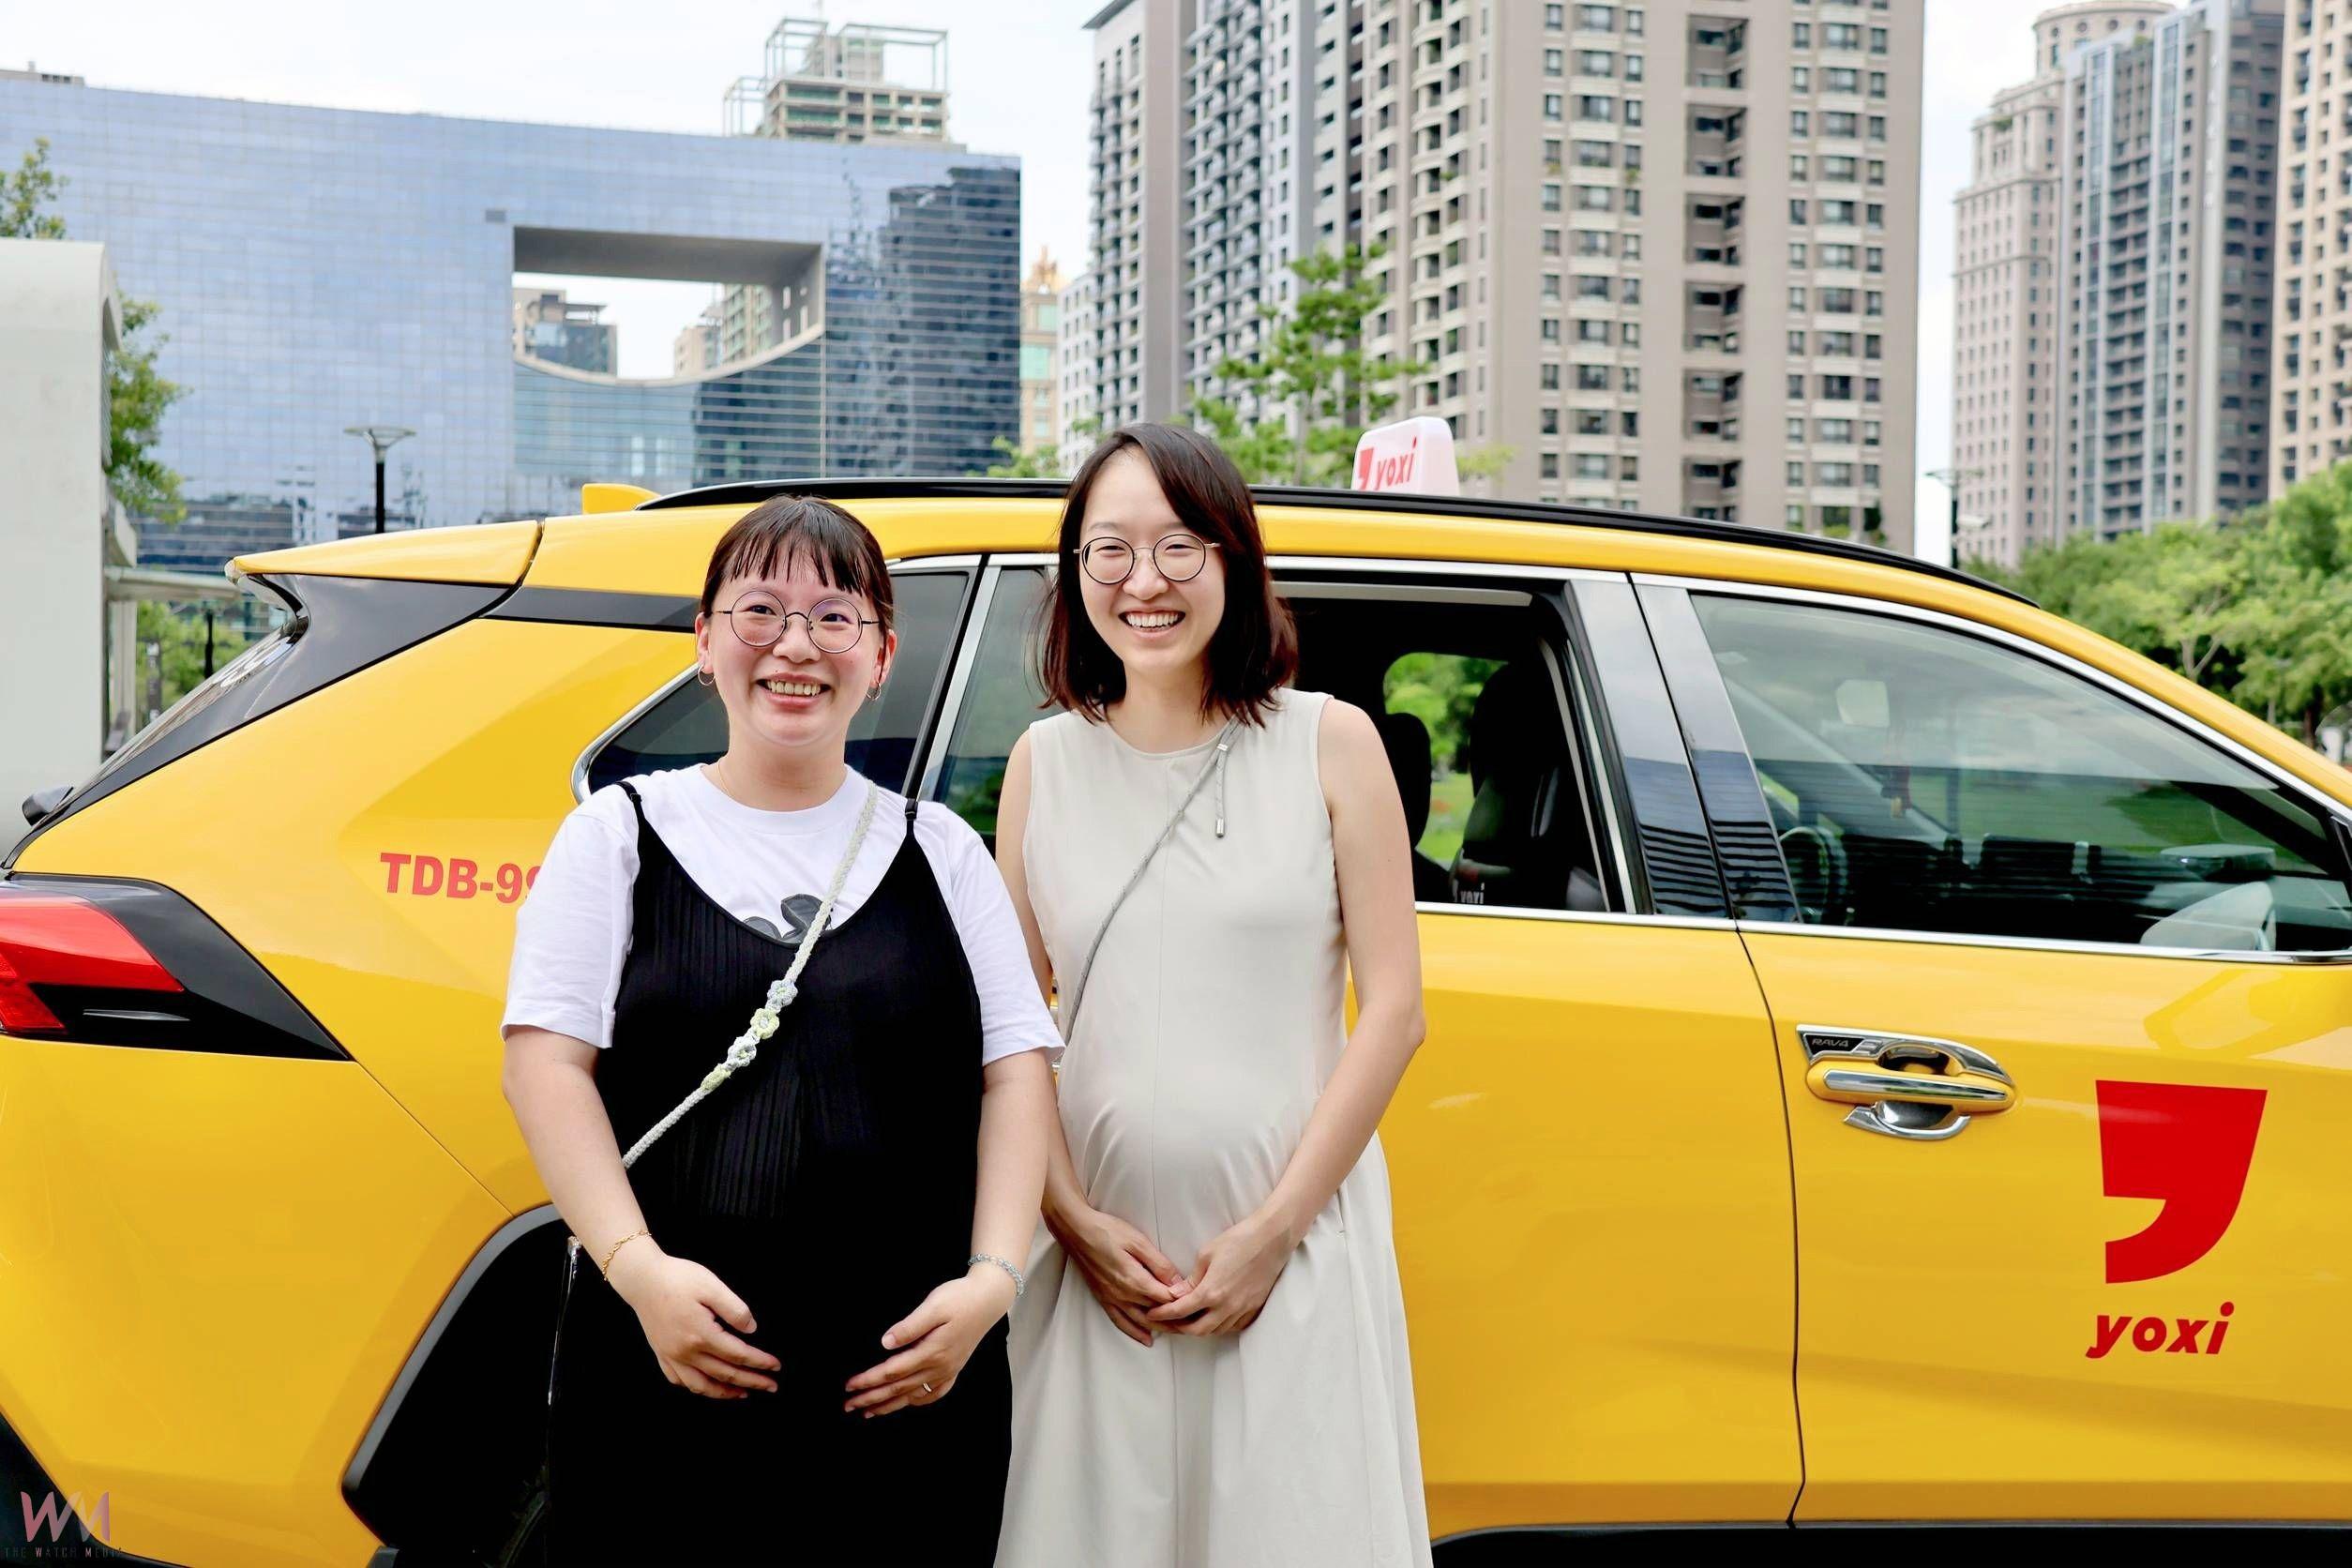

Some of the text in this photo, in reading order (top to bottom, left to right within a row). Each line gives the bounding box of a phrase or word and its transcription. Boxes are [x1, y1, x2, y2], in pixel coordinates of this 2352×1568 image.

[1375, 436, 1418, 490] yoxi
[1812, 1038, 1848, 1047] RAV4
[2085, 1301, 2235, 1359] yoxi
